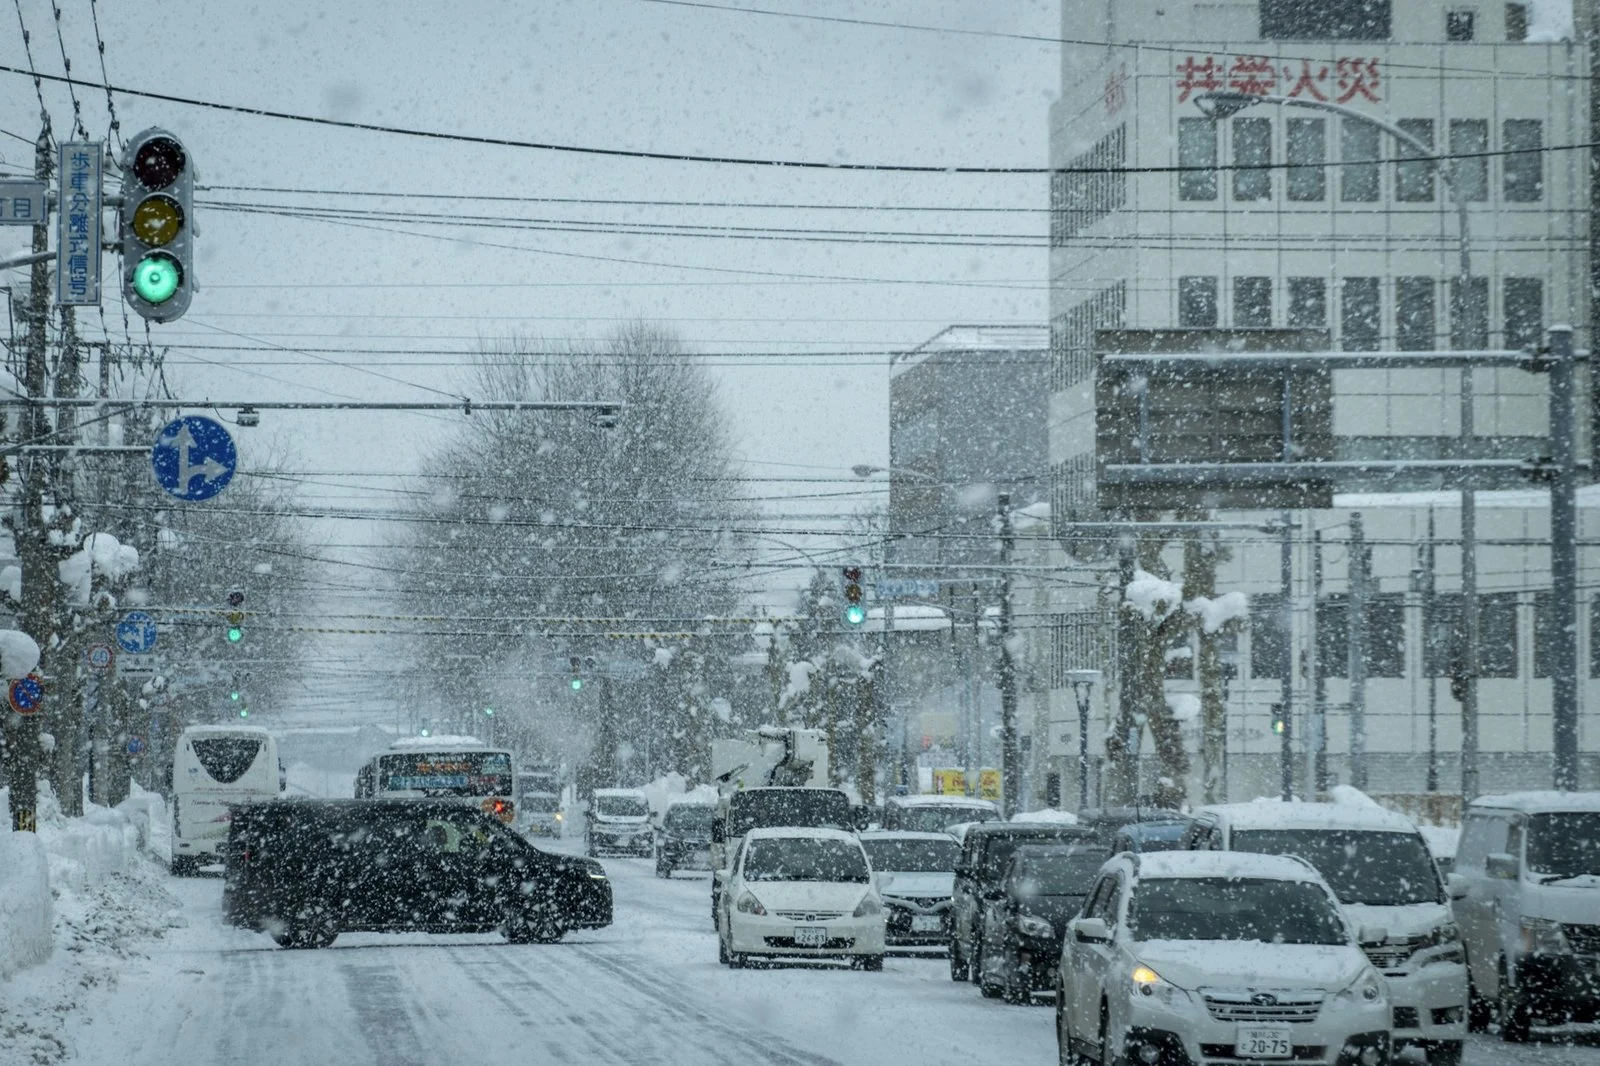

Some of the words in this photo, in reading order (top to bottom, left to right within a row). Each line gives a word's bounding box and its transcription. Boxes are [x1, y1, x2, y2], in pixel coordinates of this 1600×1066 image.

[1176, 56, 1382, 104] 共栄火災
[67, 151, 90, 296] 歩車分離式信号
[1249, 1039, 1288, 1054] 20-75
